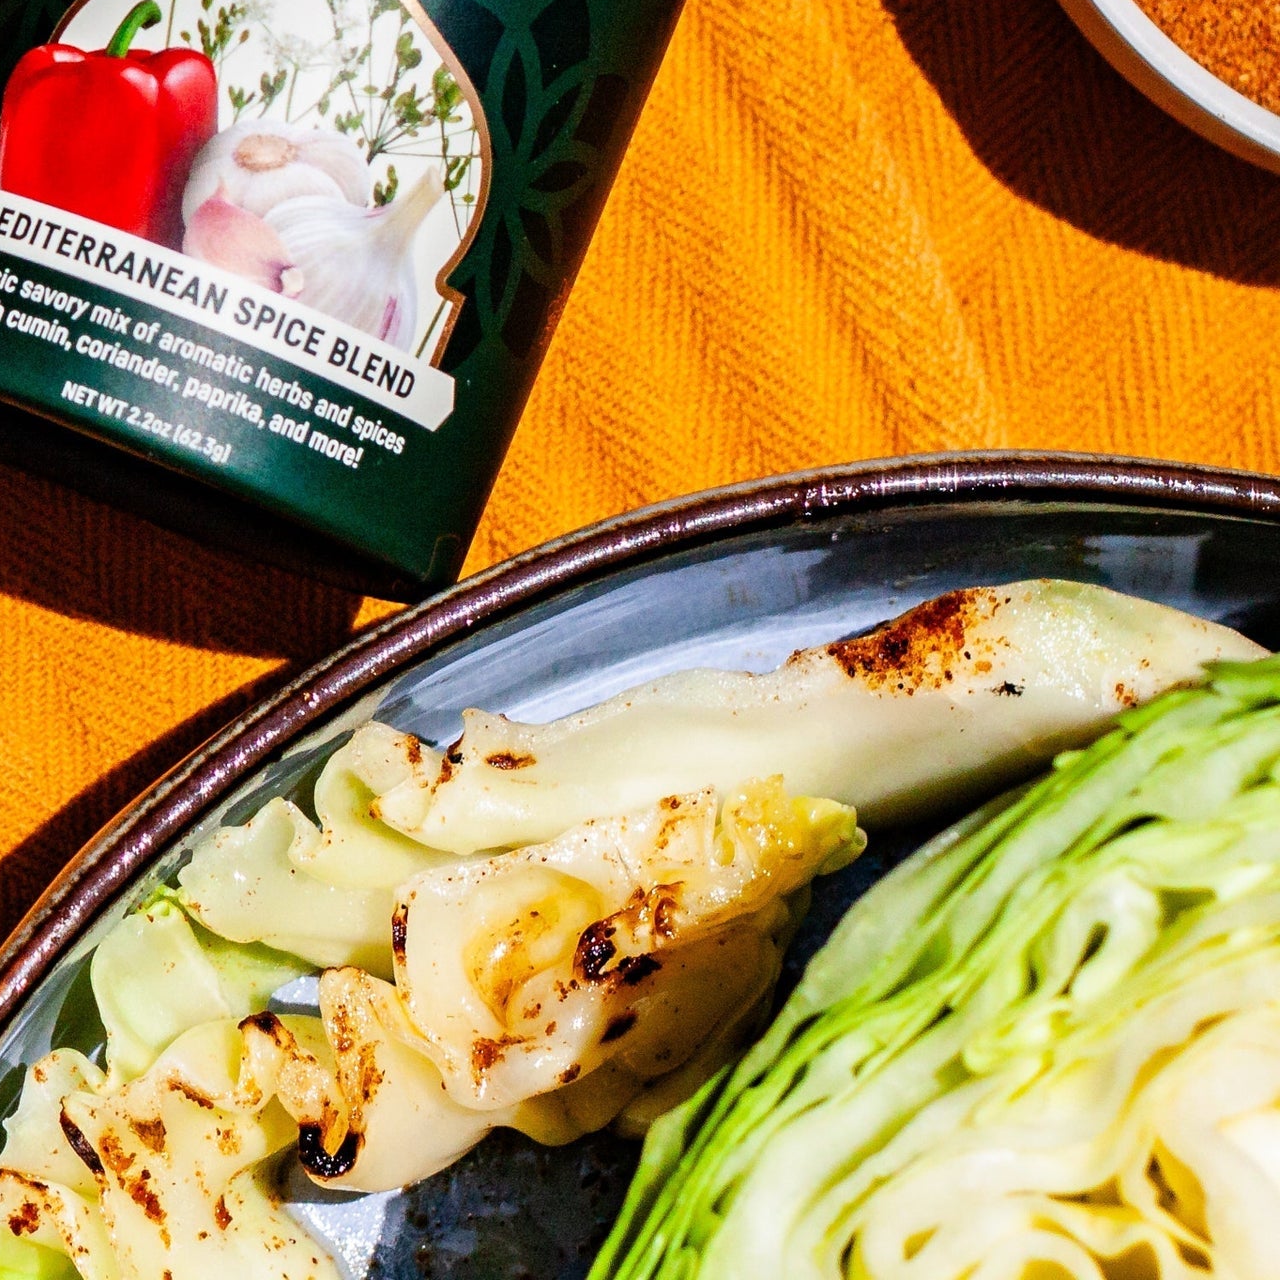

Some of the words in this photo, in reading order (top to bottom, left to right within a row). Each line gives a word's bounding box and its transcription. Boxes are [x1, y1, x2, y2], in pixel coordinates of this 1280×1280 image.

[6, 309, 72, 351] cumin,
[76, 334, 179, 393] coriander,
[182, 376, 266, 429] paprika,
[269, 413, 309, 444] and
[308, 431, 364, 469] more!
[20, 279, 89, 321] savory
[90, 305, 131, 335] mix
[133, 322, 161, 343] of
[159, 333, 253, 383] aromatic
[255, 366, 314, 410] herbs
[315, 397, 354, 428] and
[352, 415, 406, 455] spices
[234, 297, 324, 357] SPICE
[328, 337, 415, 398] BLEND
[61, 381, 100, 408] NET
[98, 393, 128, 420] WT
[126, 406, 172, 437] 2.2oz
[172, 423, 232, 464] (62.3g)
